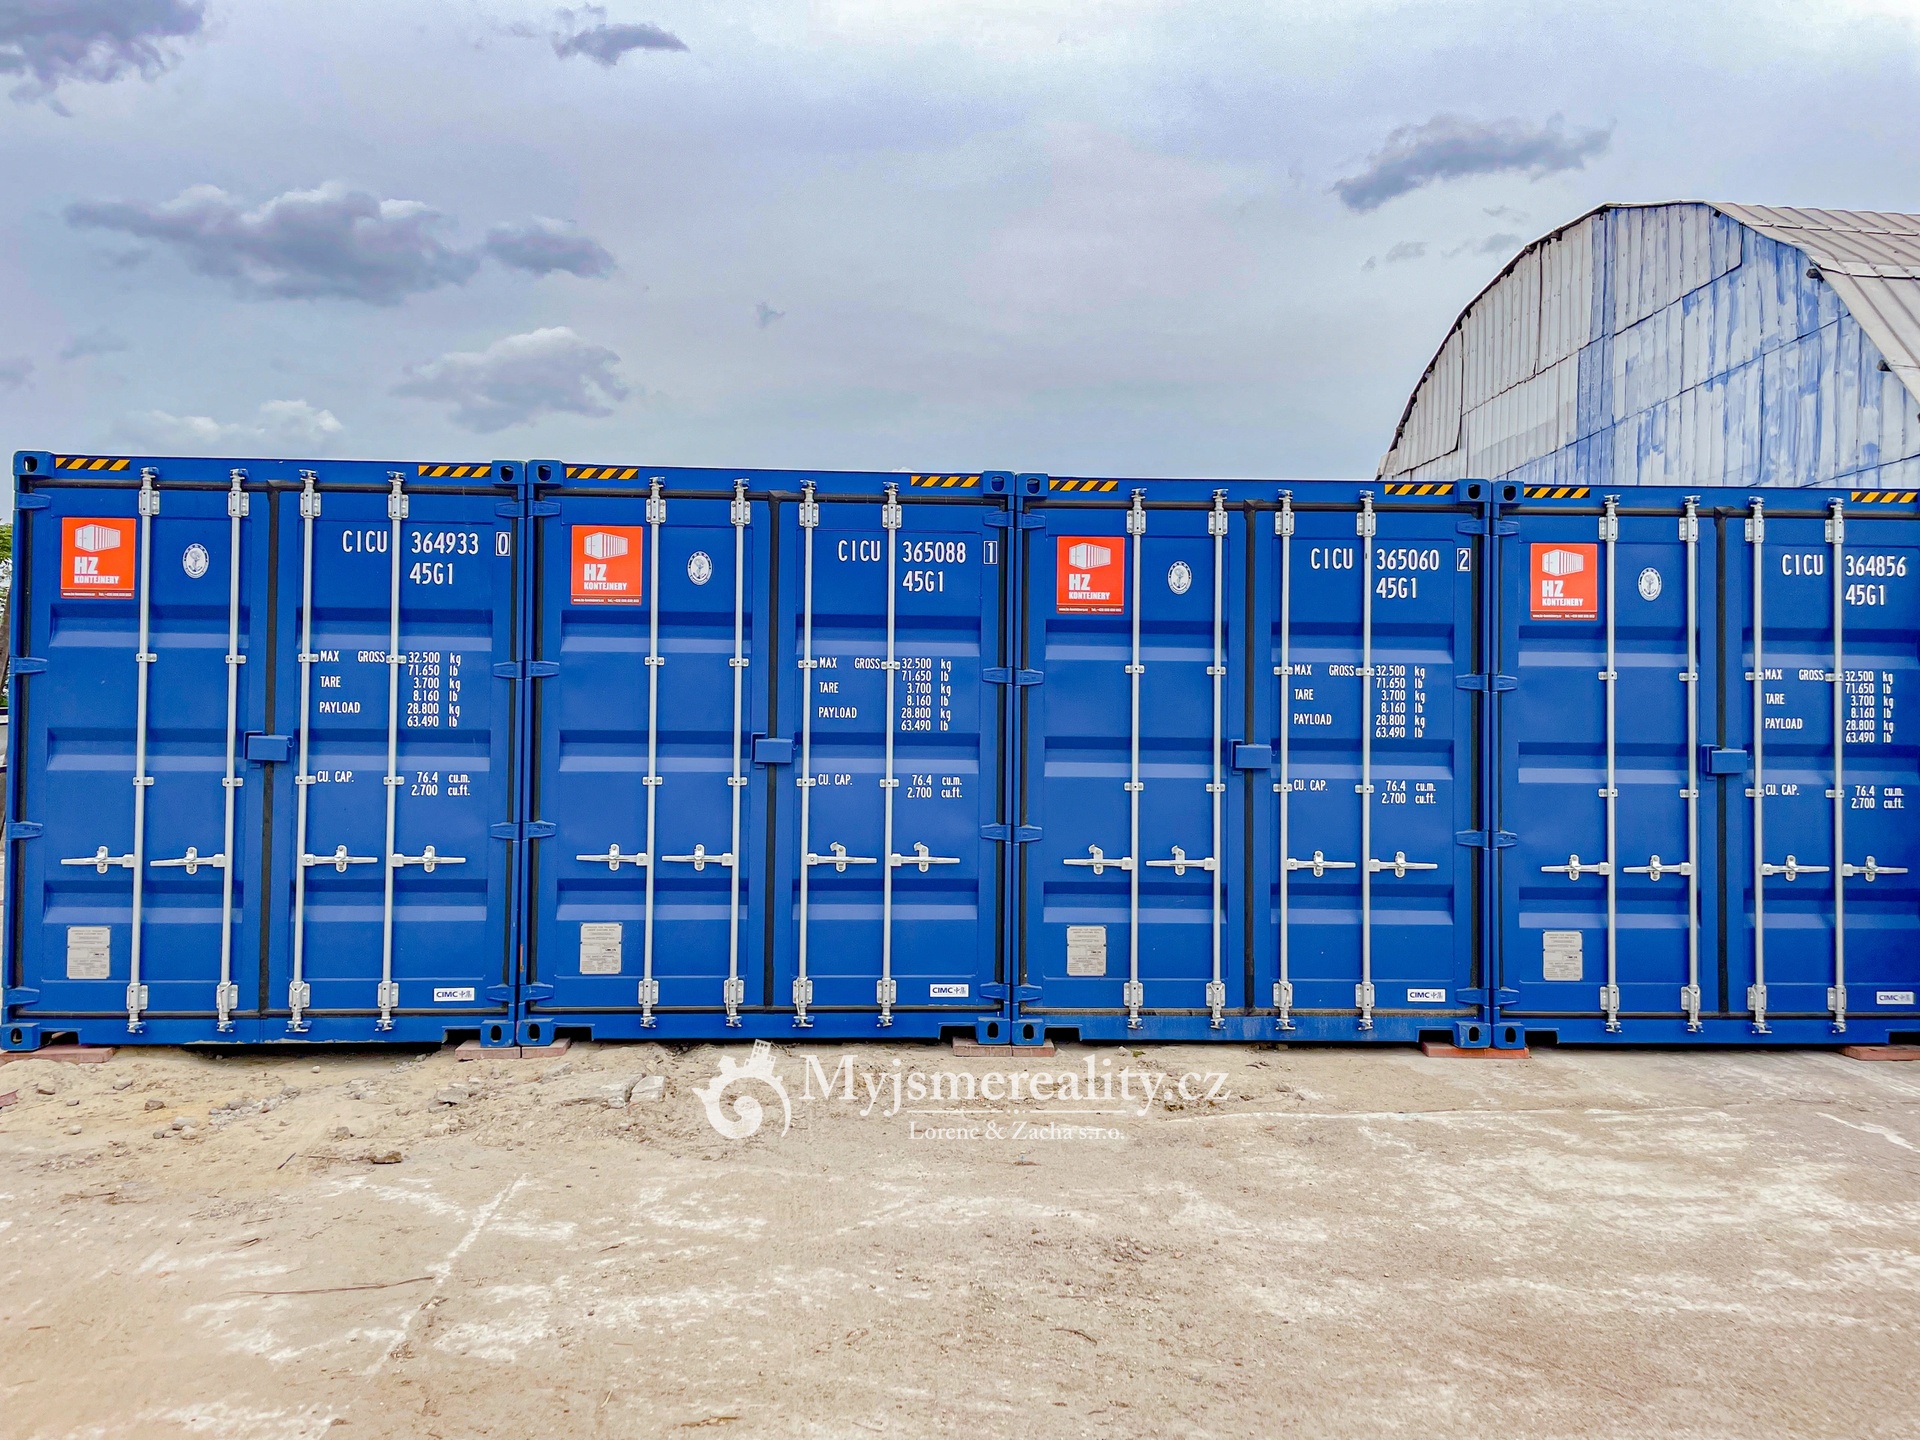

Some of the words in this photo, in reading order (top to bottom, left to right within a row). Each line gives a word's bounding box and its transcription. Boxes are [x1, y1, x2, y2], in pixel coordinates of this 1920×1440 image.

[342, 530, 388, 552] CICU
[411, 532, 479, 554] 364933
[497, 532, 509, 555] 0
[838, 540, 880, 562] CICU
[902, 541, 966, 563] 365088
[985, 542, 996, 563] 1
[74, 556, 98, 574] HZ
[1311, 548, 1353, 569] CICU
[1376, 549, 1439, 571] 365060
[1458, 549, 1470, 571] 2
[1782, 554, 1824, 576] CICU
[1845, 555, 1907, 577] 364856
[409, 563, 453, 584] 45G1
[583, 564, 607, 581] HZ
[74, 575, 119, 584] KONTEJNERY
[583, 582, 627, 590] KONTEJNERY
[902, 570, 944, 592] 45G1
[1068, 574, 1091, 591] HZ
[1376, 577, 1417, 599] 45G1
[1542, 580, 1564, 597] HZ
[1068, 591, 1110, 600] KONTEJNERY
[1845, 584, 1885, 606] 45G1
[1542, 598, 1583, 606] KONTEJNERY
[320, 651, 339, 662] MAX
[358, 651, 385, 662] GROSS
[408, 652, 440, 664] 32.500
[449, 653, 461, 666] kg
[819, 657, 837, 668] MAX
[854, 658, 880, 669] GROSS
[902, 658, 931, 669] 32.500
[940, 659, 951, 673] kg
[408, 665, 439, 676] 71.650
[450, 665, 458, 676] lb
[902, 671, 931, 681] 71.650
[941, 671, 948, 681] lb
[1294, 665, 1312, 675] MAX
[1329, 665, 1354, 676] GROSS
[1376, 665, 1405, 676] 32.500
[1414, 666, 1425, 679] kg
[1765, 669, 1782, 680] MAX
[1799, 670, 1824, 681] GROSS
[1845, 671, 1874, 682] 32.500
[1883, 672, 1893, 684] kg
[320, 676, 341, 687] TARE
[413, 678, 439, 688] 3.700
[449, 678, 461, 692] kg
[819, 682, 839, 693] TARE
[907, 683, 931, 694] 3.700
[940, 684, 951, 697] kg
[1376, 678, 1406, 688] 71.650
[1414, 678, 1422, 688] lb
[1845, 683, 1874, 694] 71.650
[1883, 683, 1891, 694] lb
[413, 691, 439, 701] 8.160
[449, 691, 457, 701] lb
[907, 695, 931, 706] 8.160
[940, 696, 948, 706] lb
[1294, 689, 1313, 700] TARE
[1381, 690, 1405, 701] 3.700
[1415, 690, 1426, 703] kg
[1765, 694, 1785, 704] TARE
[1851, 695, 1875, 706] 3.700
[1883, 696, 1894, 709] kg
[319, 702, 360, 713] PAYLOAD
[407, 703, 439, 714] 28.800
[449, 704, 460, 717] kg
[818, 707, 857, 718] PAYLOAD
[901, 708, 931, 719] 28.800
[940, 709, 951, 721] kg
[1381, 702, 1406, 713] 8.160
[1414, 703, 1423, 713] lb
[1851, 708, 1875, 718] 8.160
[1884, 708, 1891, 718] lb
[407, 716, 439, 727] 63.490
[449, 716, 457, 727] lb
[901, 720, 931, 731] 63.490
[940, 720, 948, 731] lb
[1294, 714, 1332, 725] PAYLOAD
[1376, 715, 1406, 726] 28.800
[1414, 715, 1425, 728] kg
[1765, 718, 1803, 729] PAYLOAD
[1846, 720, 1875, 731] 28.800
[1883, 721, 1894, 733] kg
[1376, 727, 1406, 738] 63.490
[1414, 727, 1422, 738] lb
[1845, 732, 1875, 743] 63.490
[1883, 733, 1891, 743] lb
[317, 771, 331, 782] CU.
[335, 771, 354, 782] CAP.
[417, 772, 438, 783] 76.4
[448, 774, 470, 783] cu.m.
[818, 774, 831, 785] CU.
[835, 774, 852, 785] CAP.
[912, 775, 932, 786] 76.4
[942, 777, 962, 786] cu.m.
[411, 785, 438, 796] 2.700
[448, 785, 470, 796] cu.ft.
[1293, 780, 1306, 791] CU.
[1310, 780, 1328, 791] CAP.
[1386, 781, 1406, 791] 76.4
[1415, 782, 1436, 791] cu.m.
[1765, 784, 1778, 795] CU.
[1782, 785, 1800, 796] CAP.
[1855, 786, 1875, 796] 76.4
[1884, 787, 1904, 796] cu.m.
[907, 787, 932, 798] 2.700
[941, 787, 962, 798] cu.ft.
[1382, 793, 1406, 804] 2.700
[1415, 793, 1436, 804] cu.ft.
[1851, 798, 1875, 808] 2.700
[1883, 798, 1904, 809] cu.ft.
